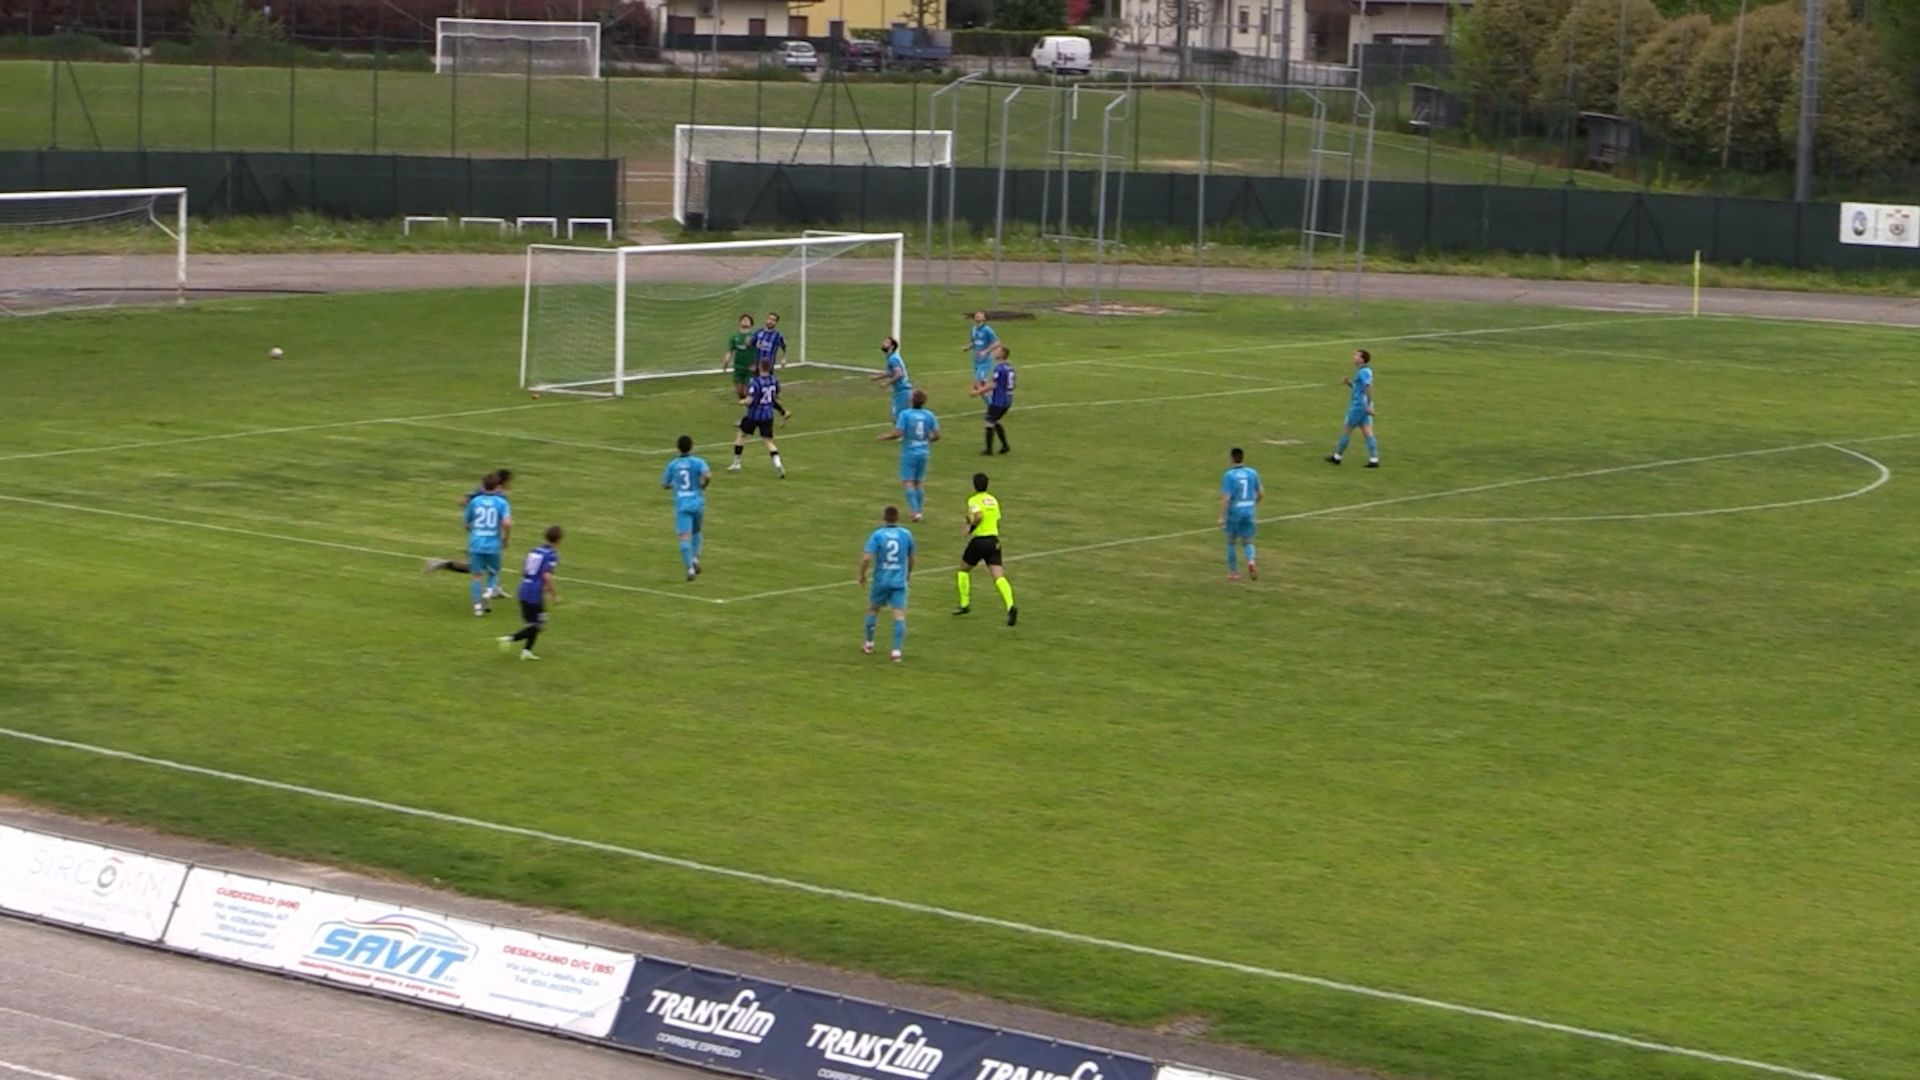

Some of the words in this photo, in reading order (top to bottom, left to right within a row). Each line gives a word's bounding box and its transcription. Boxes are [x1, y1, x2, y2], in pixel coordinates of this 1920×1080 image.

[759, 384, 777, 405] 20
[915, 420, 925, 440] 4
[679, 469, 691, 490] 3
[473, 506, 499, 528] 20
[886, 539, 899, 562] 2
[313, 928, 468, 980] SAVIT
[502, 944, 569, 966] DESENZANO
